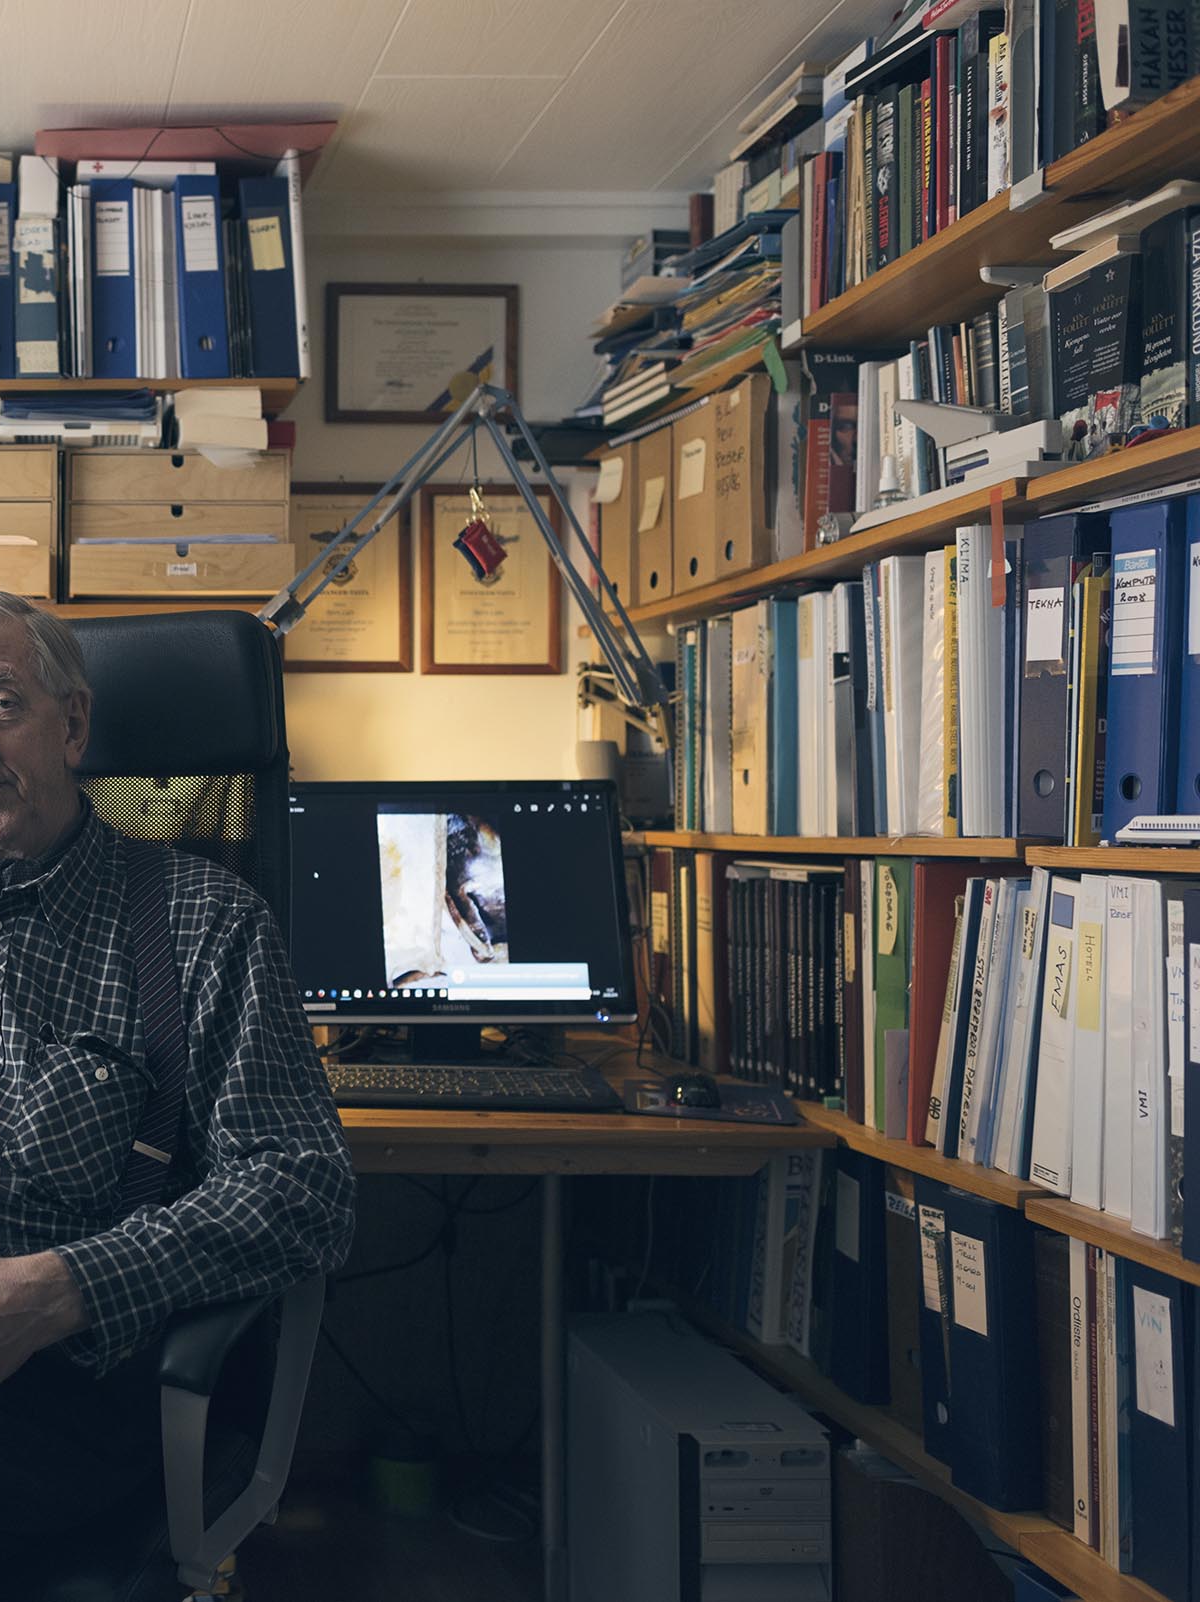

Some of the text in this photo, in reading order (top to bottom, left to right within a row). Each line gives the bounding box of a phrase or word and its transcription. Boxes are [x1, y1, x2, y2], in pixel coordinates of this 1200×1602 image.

[1136, 7, 1161, 89] HÅKAN
[1191, 267, 1200, 355] MARKLUND
[1063, 316, 1089, 336] FOLLET
[814, 353, 856, 364] D-Link
[960, 537, 970, 584] KLIMA
[1029, 597, 1064, 611] TEKNA
[1120, 592, 1147, 603] 2008
[984, 886, 993, 906] 3M
[1111, 886, 1129, 900] VMI
[1085, 934, 1096, 982] HOTELL
[1138, 1089, 1148, 1119] VMI
[1072, 1296, 1082, 1348] Ordliste
